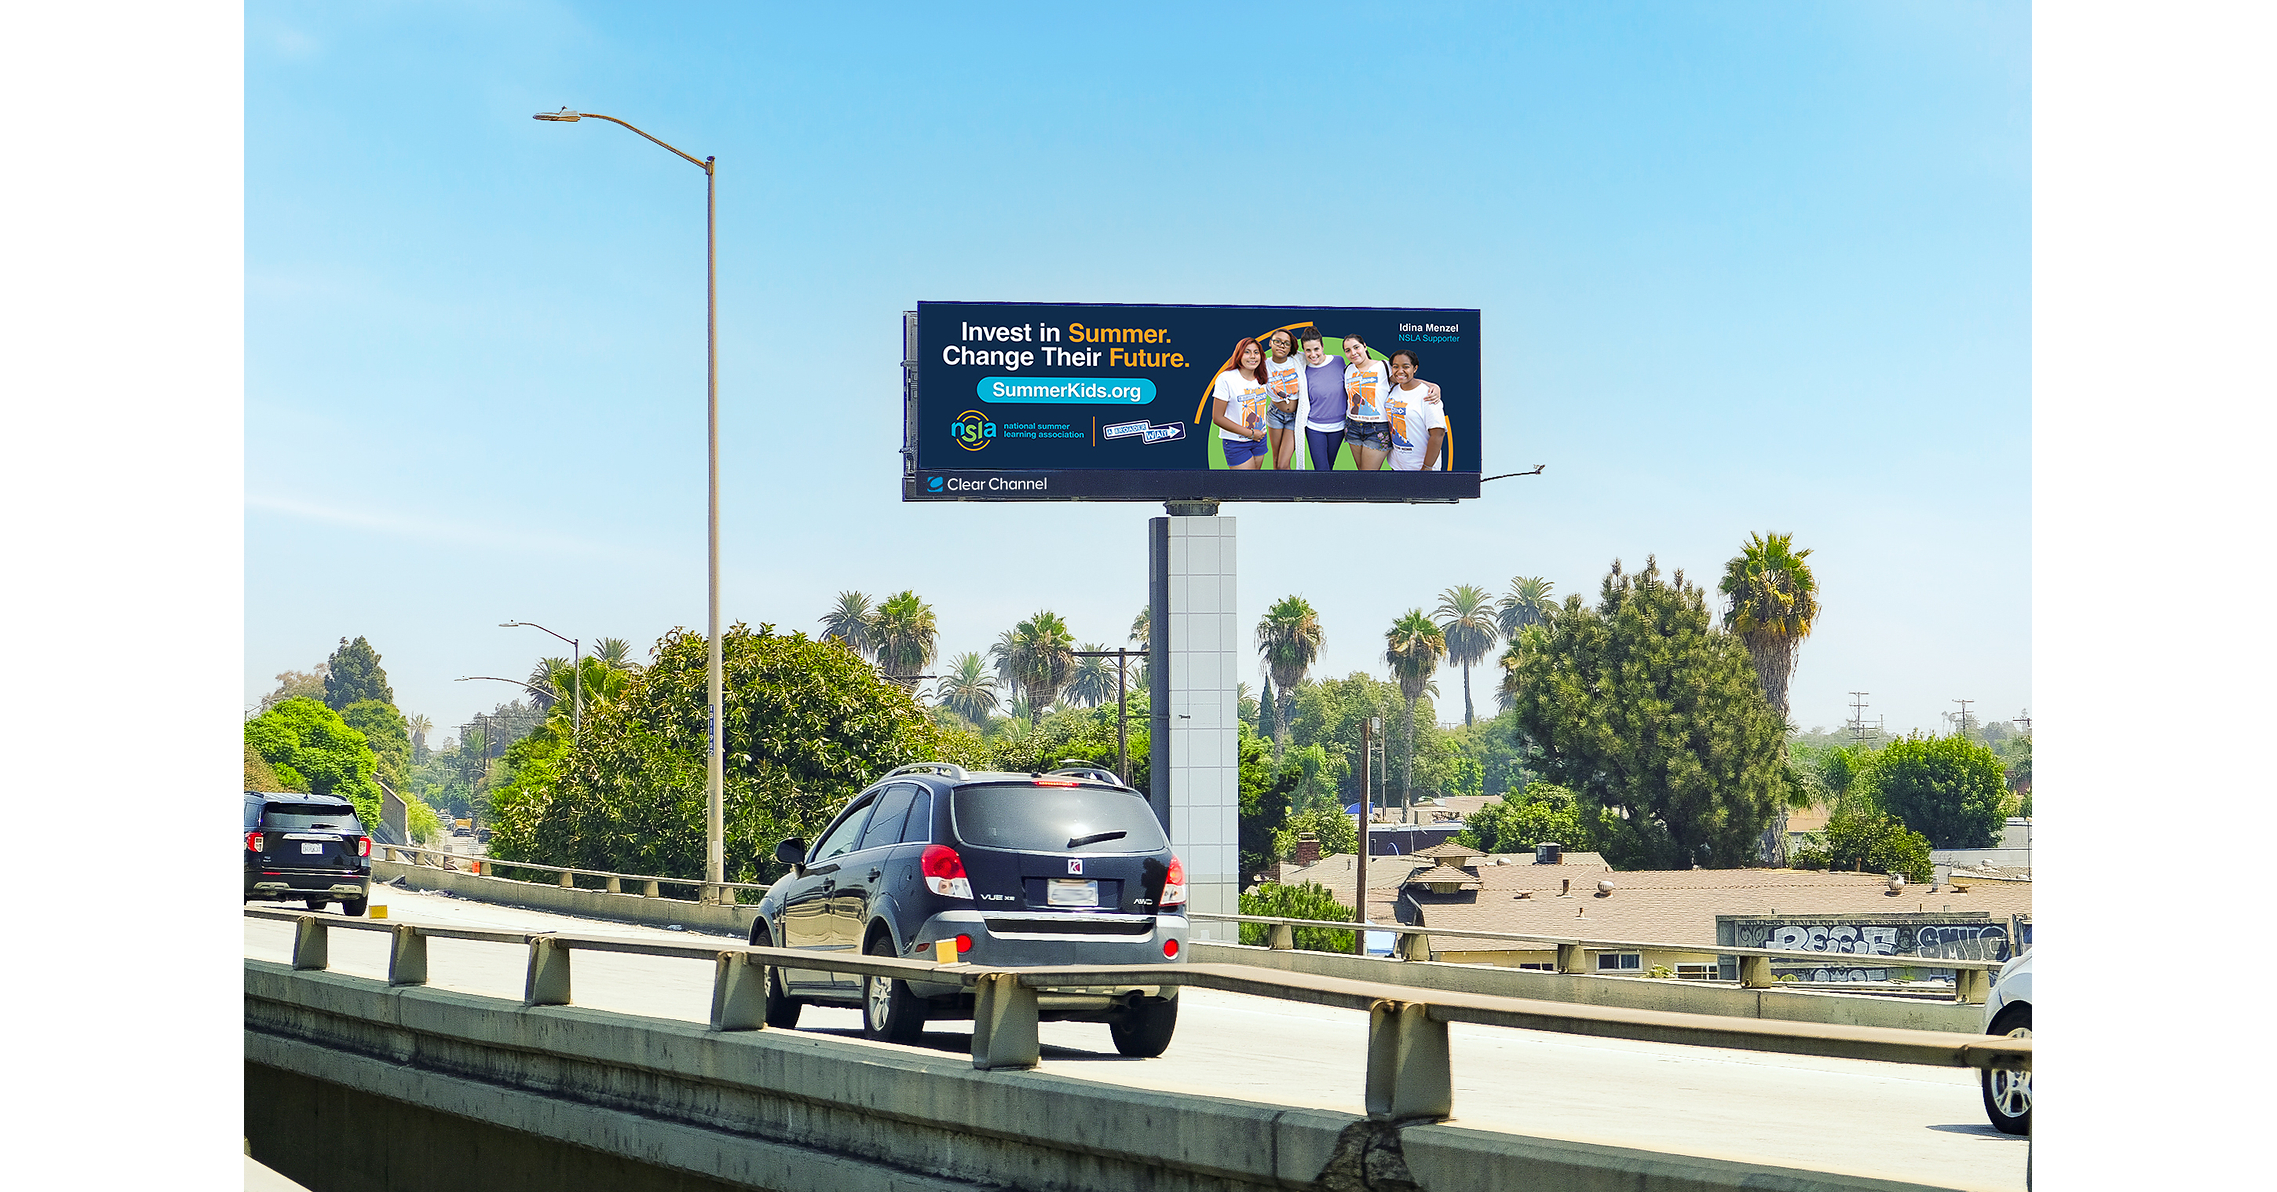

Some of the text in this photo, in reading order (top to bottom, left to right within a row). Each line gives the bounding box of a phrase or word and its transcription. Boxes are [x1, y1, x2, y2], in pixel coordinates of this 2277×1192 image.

[961, 321, 1172, 344] Invest in Summer.
[1399, 322, 1459, 333] Idina Menzel
[1398, 333, 1460, 344] NSLA Supporter
[942, 344, 1190, 372] Change Their Future.
[992, 381, 1141, 403] SummerKids.org
[951, 420, 997, 443] nsla
[1003, 422, 1036, 430] national
[1003, 430, 1085, 440] learning association
[946, 476, 1048, 491] Clear Channel
[980, 893, 1004, 901] VUE
